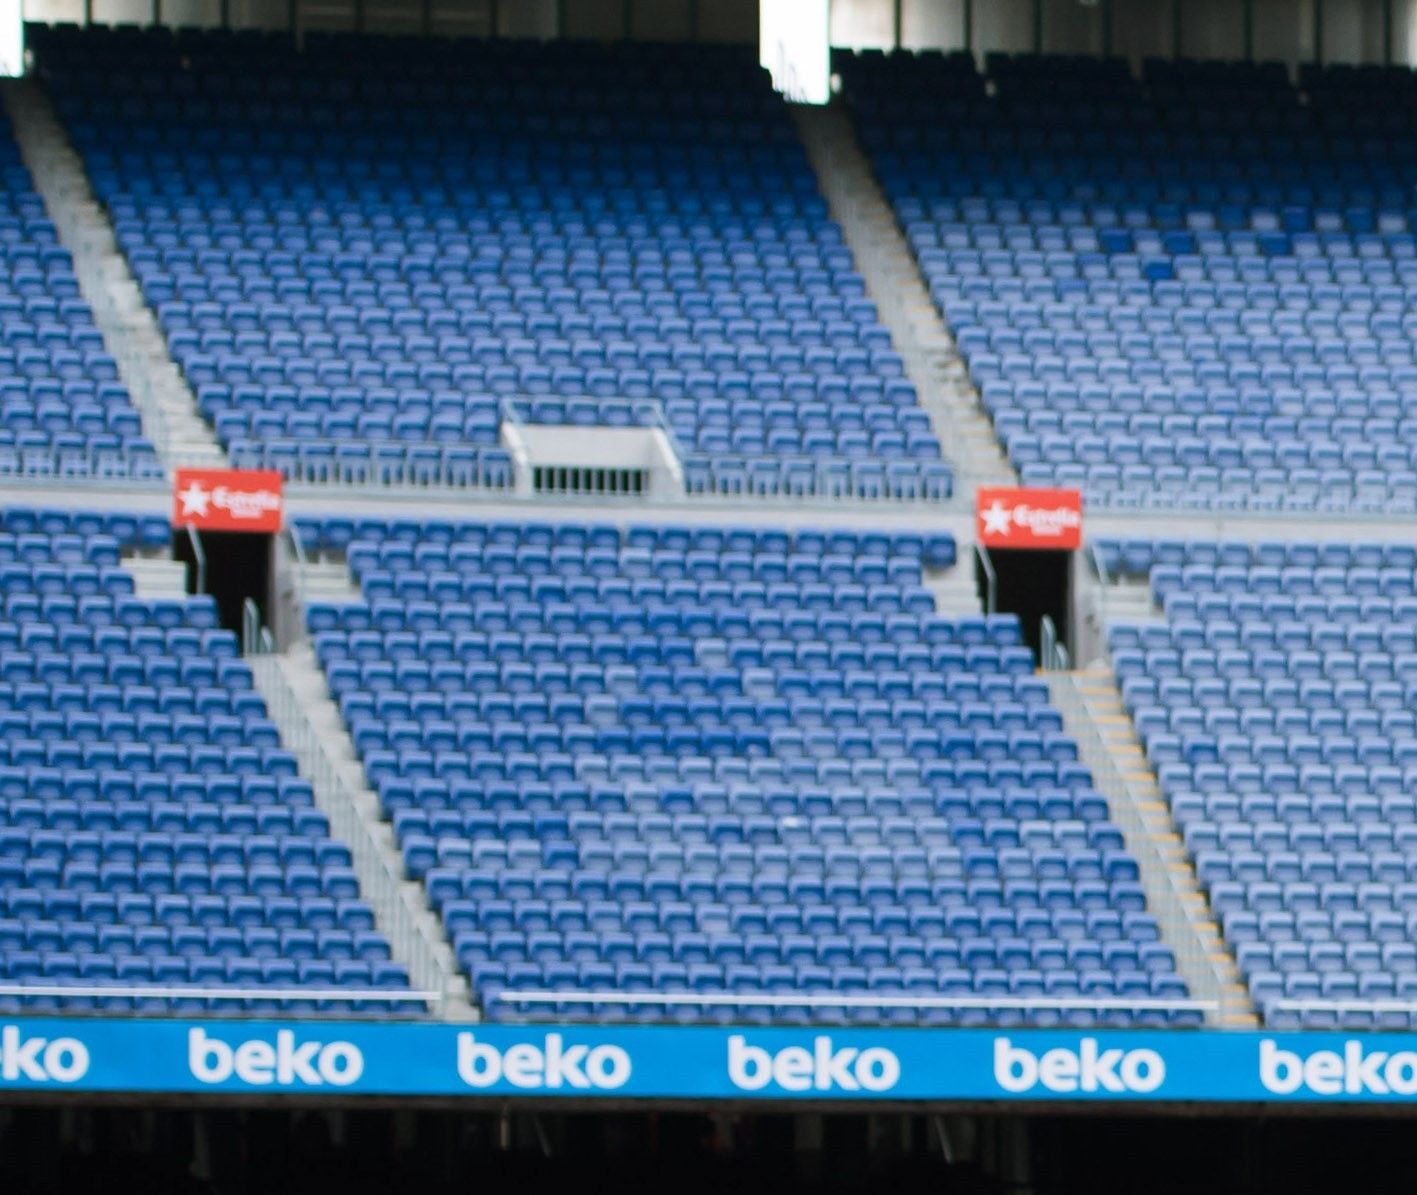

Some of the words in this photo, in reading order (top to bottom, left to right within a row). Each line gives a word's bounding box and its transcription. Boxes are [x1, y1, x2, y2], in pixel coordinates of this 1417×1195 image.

[0, 1026, 89, 1082] ko
[189, 1028, 363, 1085] beko
[457, 1032, 631, 1089] beko
[728, 1035, 900, 1091] beko
[994, 1037, 1165, 1092] beko
